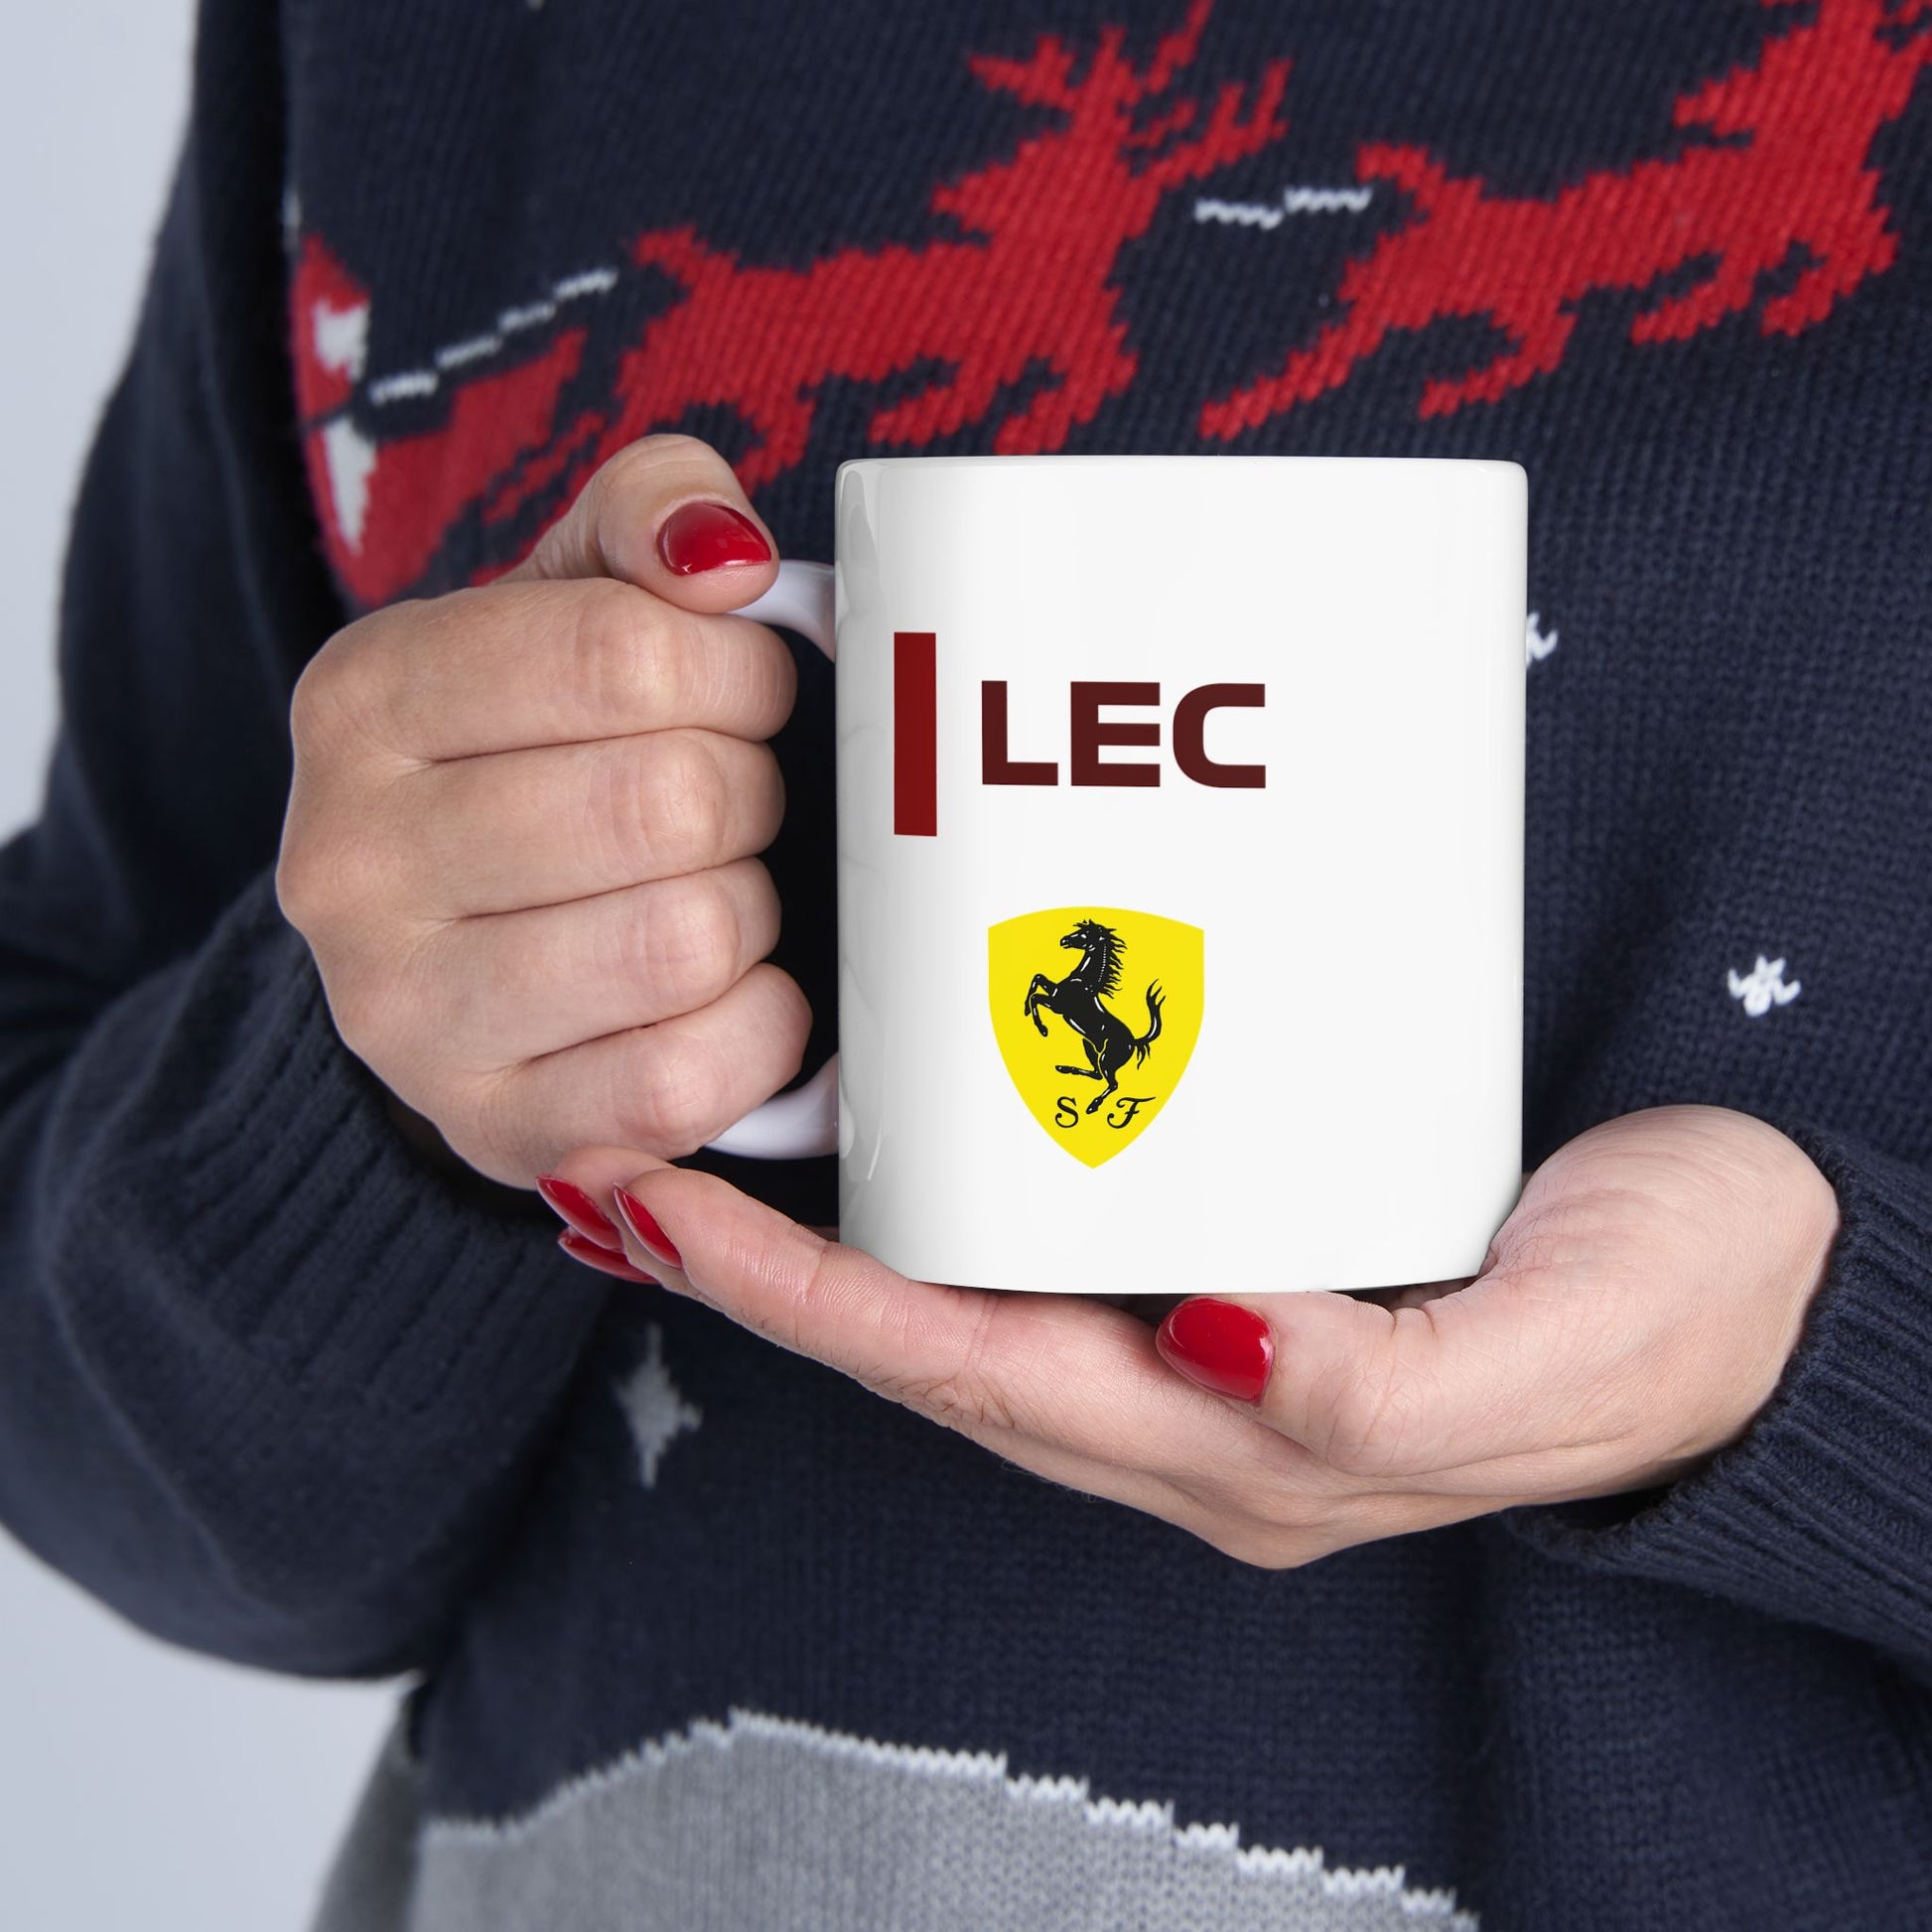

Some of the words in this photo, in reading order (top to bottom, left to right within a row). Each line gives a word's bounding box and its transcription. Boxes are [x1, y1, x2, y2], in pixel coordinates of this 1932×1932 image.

[981, 680, 1267, 789] LEC
[1054, 1096, 1079, 1128] S
[1106, 1096, 1157, 1129] F
